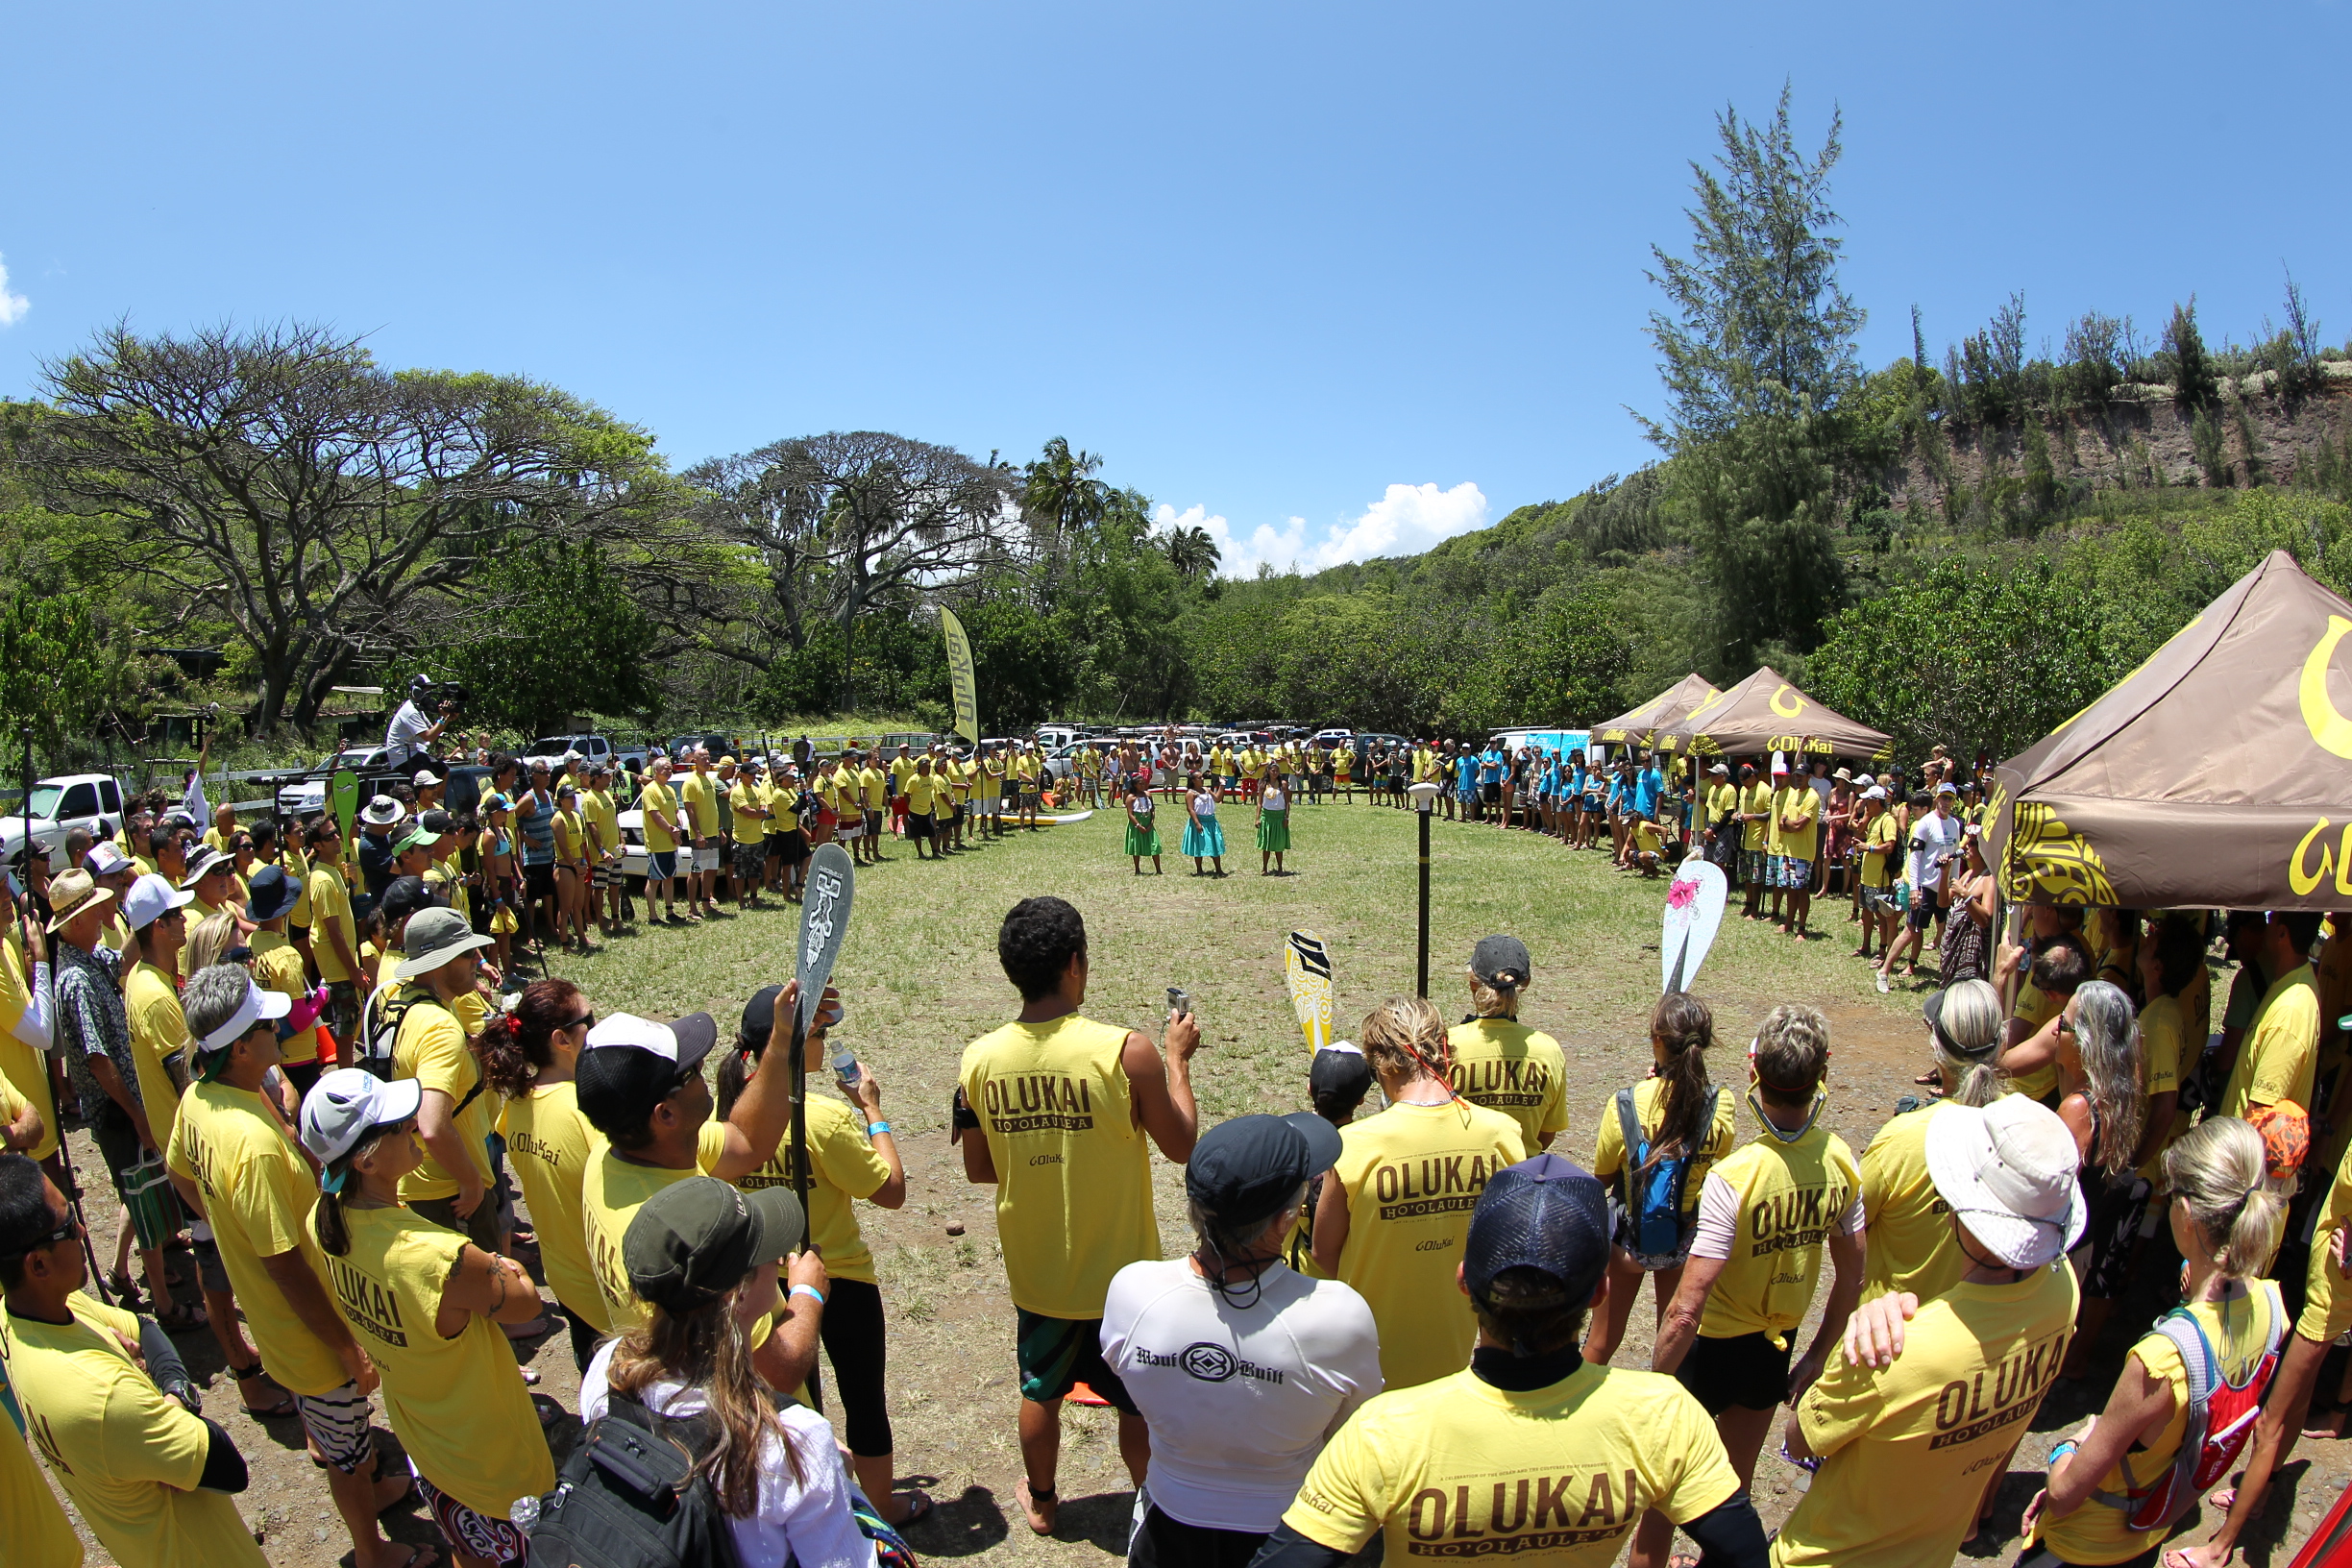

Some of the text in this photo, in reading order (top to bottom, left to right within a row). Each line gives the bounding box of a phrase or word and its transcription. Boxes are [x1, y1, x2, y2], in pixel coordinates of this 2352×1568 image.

[1450, 1061, 1548, 1095] OLUKAI
[985, 1076, 1091, 1115] OLUKAI
[517, 1132, 561, 1166] OluKai
[1424, 1236, 1455, 1251] OluKai
[1238, 1360, 1284, 1384] Built
[1935, 1334, 2065, 1431] OLUKA
[1409, 1468, 1636, 1541] OLUKAI
[1418, 1528, 1617, 1556] HO'OLAULE'A
